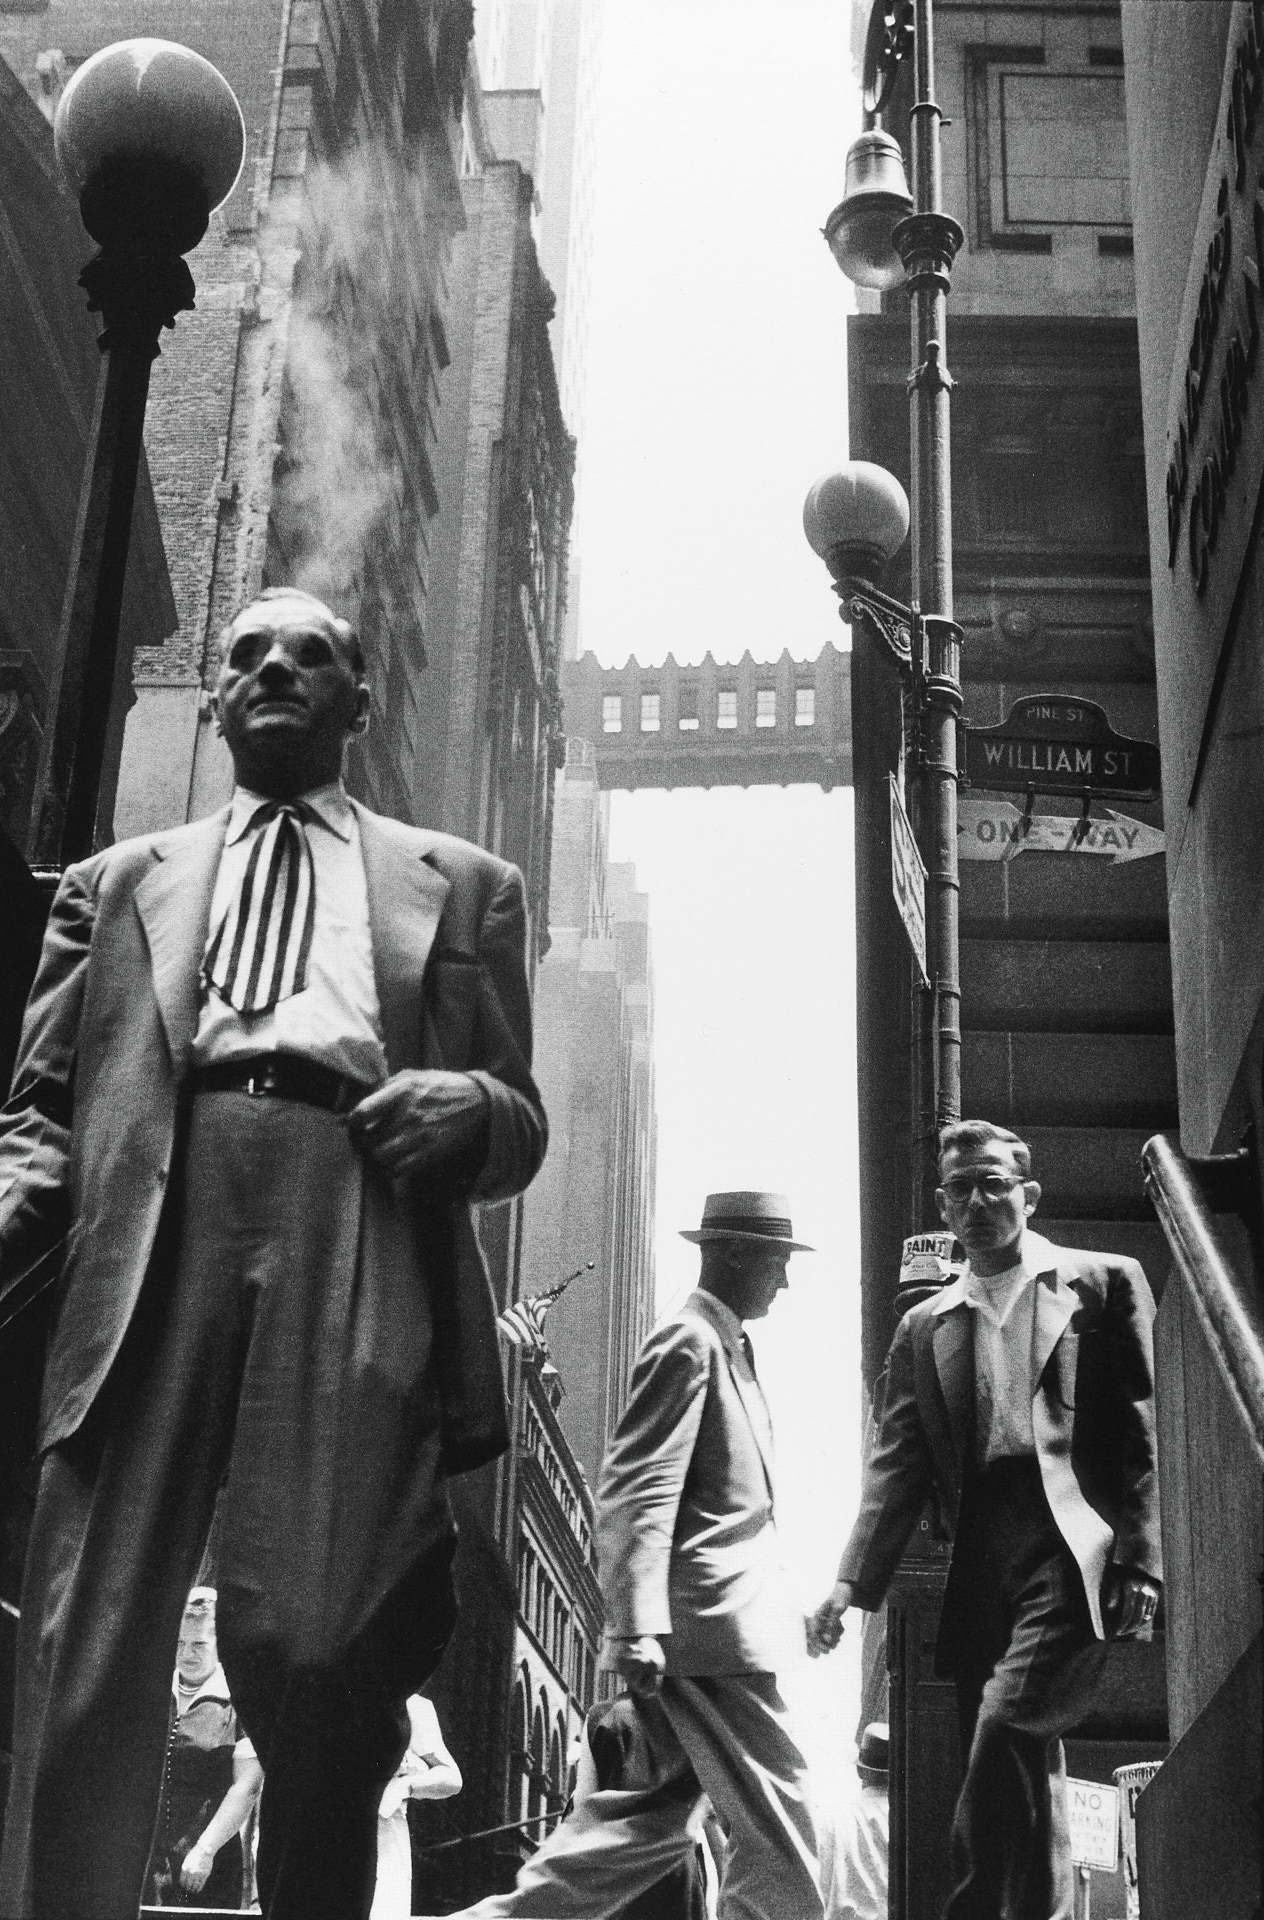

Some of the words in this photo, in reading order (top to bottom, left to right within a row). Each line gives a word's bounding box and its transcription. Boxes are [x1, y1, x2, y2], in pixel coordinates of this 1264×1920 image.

[1026, 706, 1061, 719] PINE
[1067, 708, 1083, 722] ST
[984, 743, 1093, 774] WILLIAM
[1104, 750, 1133, 775] ST
[1074, 1790, 1102, 1810] NO
[1070, 1812, 1112, 1833] ARKING
